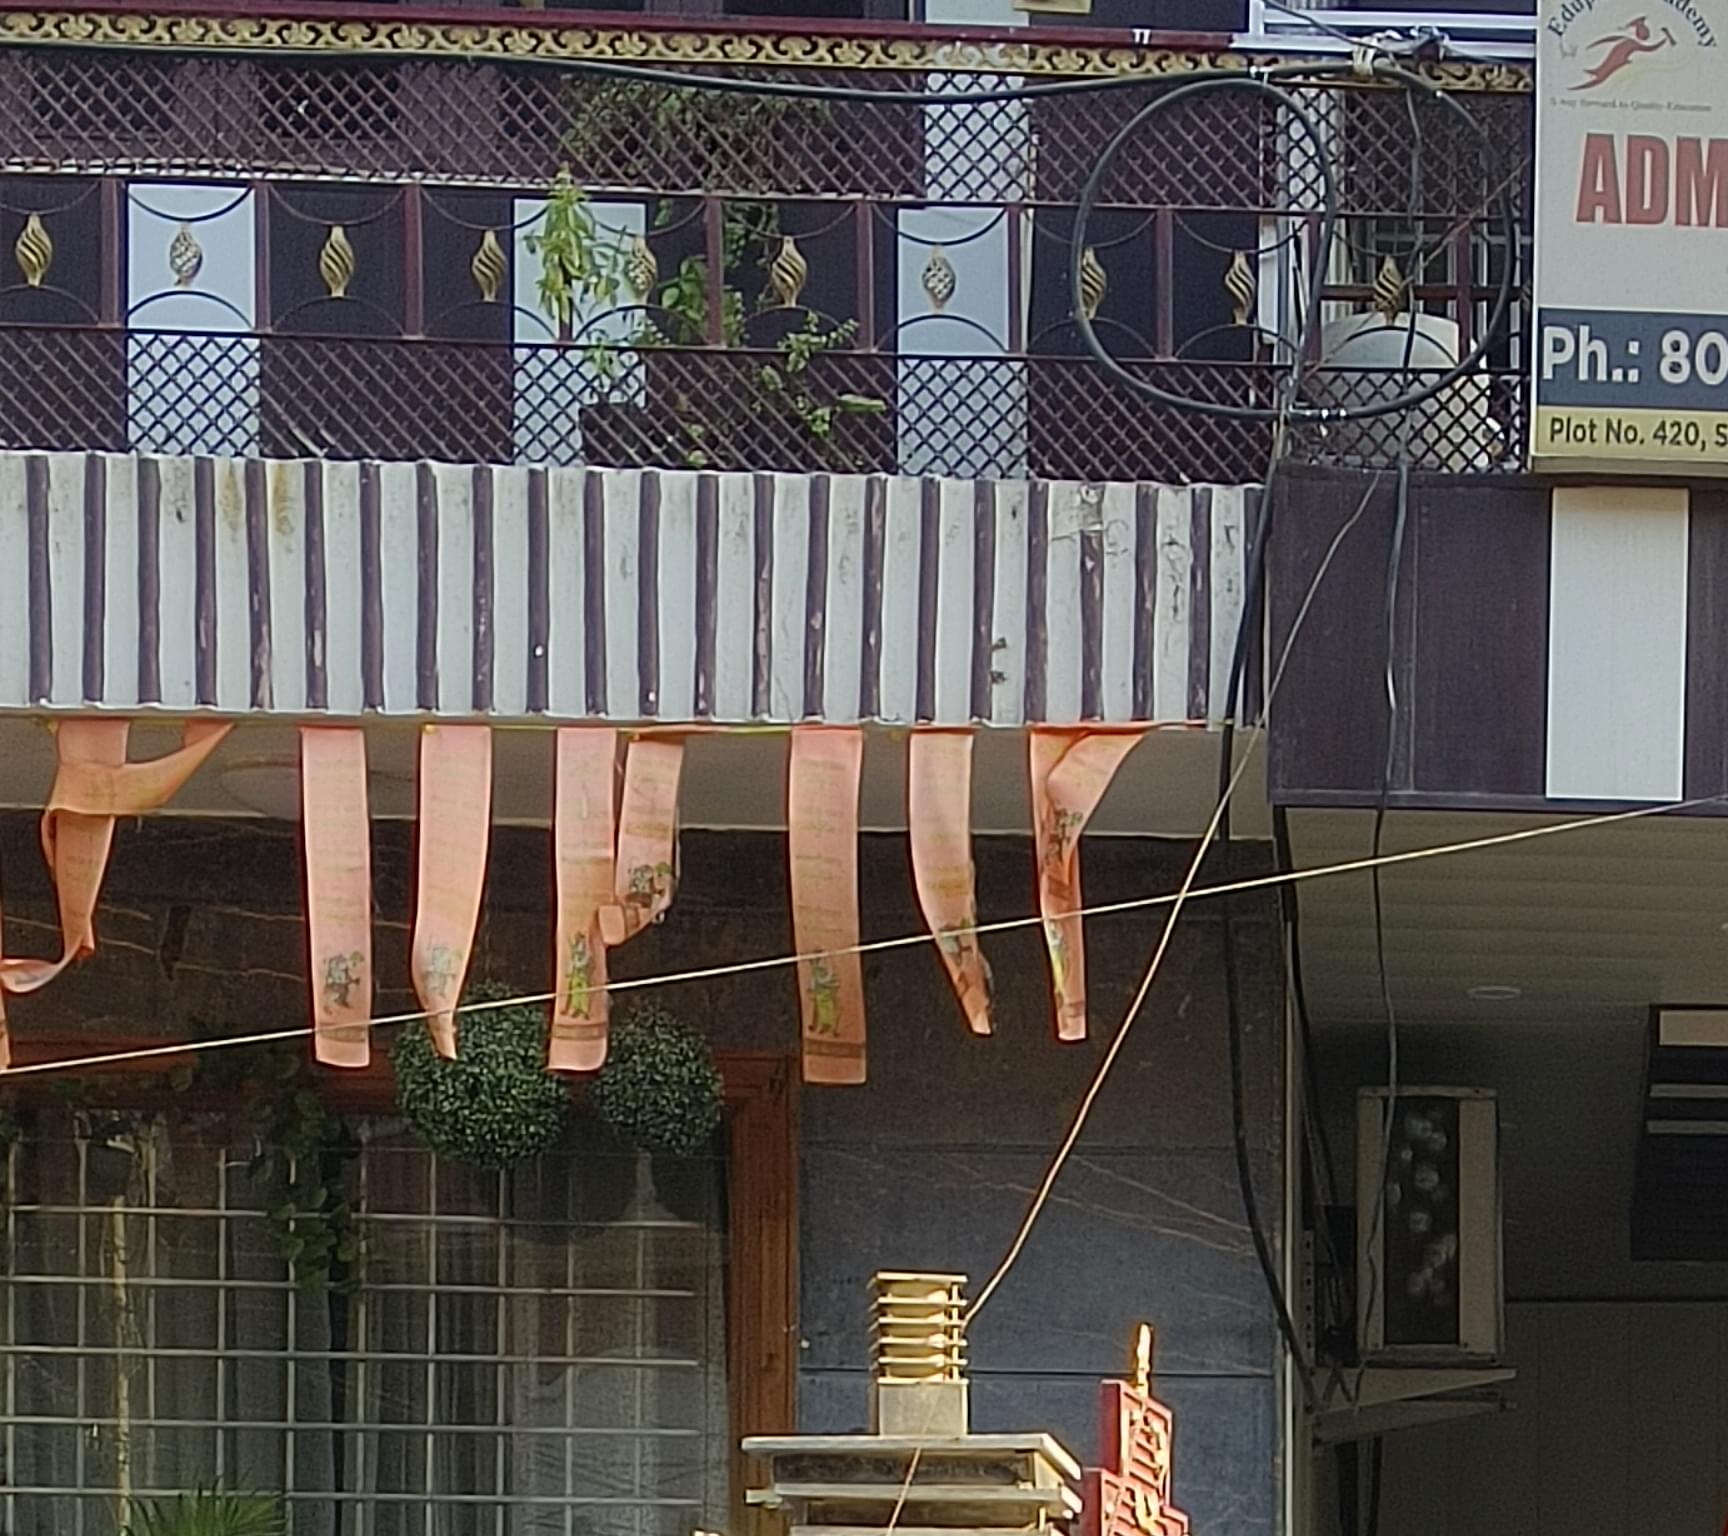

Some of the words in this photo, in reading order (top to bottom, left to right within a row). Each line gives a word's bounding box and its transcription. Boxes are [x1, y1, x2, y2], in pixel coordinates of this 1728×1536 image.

[1541, 325, 1640, 383] Ph.:
[1549, 417, 1599, 444] Plot
[1605, 417, 1646, 446] No.
[1652, 421, 1708, 452] 420,
